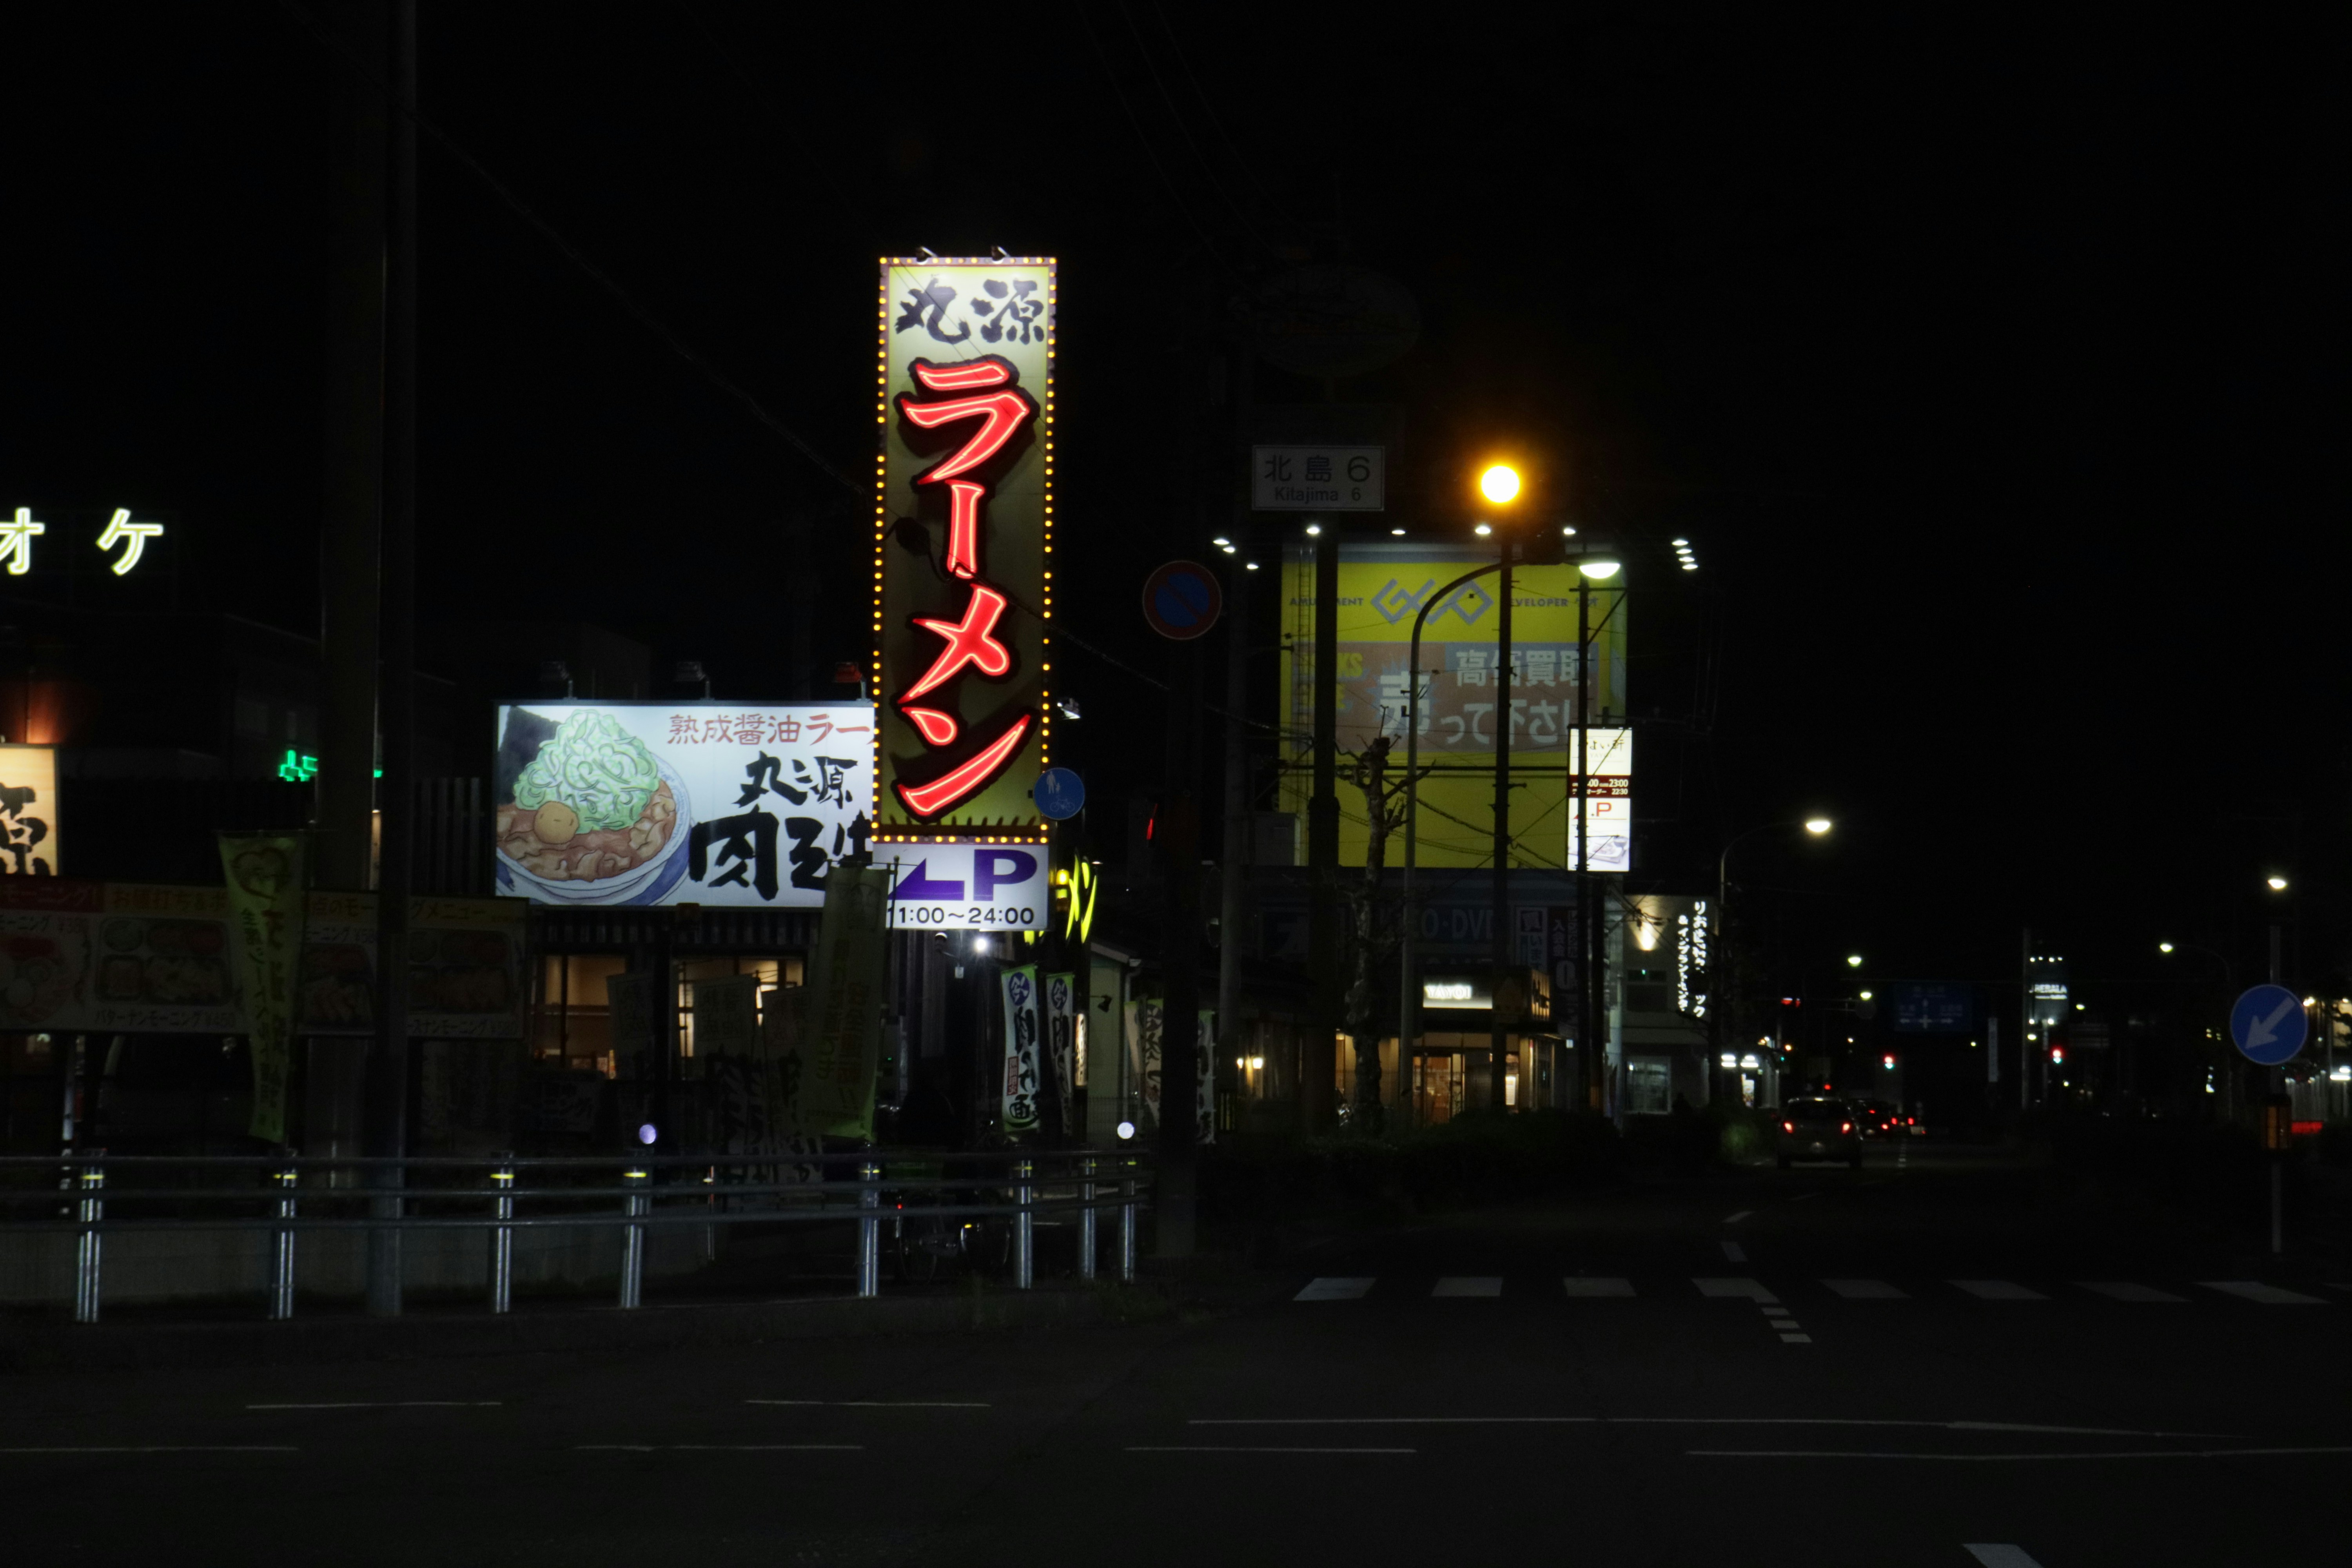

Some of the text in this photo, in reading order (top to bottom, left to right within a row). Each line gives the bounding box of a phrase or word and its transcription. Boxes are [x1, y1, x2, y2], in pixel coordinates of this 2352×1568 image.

[895, 278, 1045, 346] 丸源
[1275, 487, 1361, 504] Kitajima 6
[0, 507, 163, 576] オケ
[895, 359, 1035, 819] ラーメン
[1290, 597, 1364, 606] AMUMENT
[1511, 598, 1568, 607] EVELOPER
[667, 713, 875, 746] 熟成醤油ラー
[732, 751, 858, 809] 丸源
[1609, 779, 1629, 788] 23:00
[1596, 802, 1612, 817] P
[973, 849, 1038, 902] P
[1552, 919, 1565, 957] 入会金
